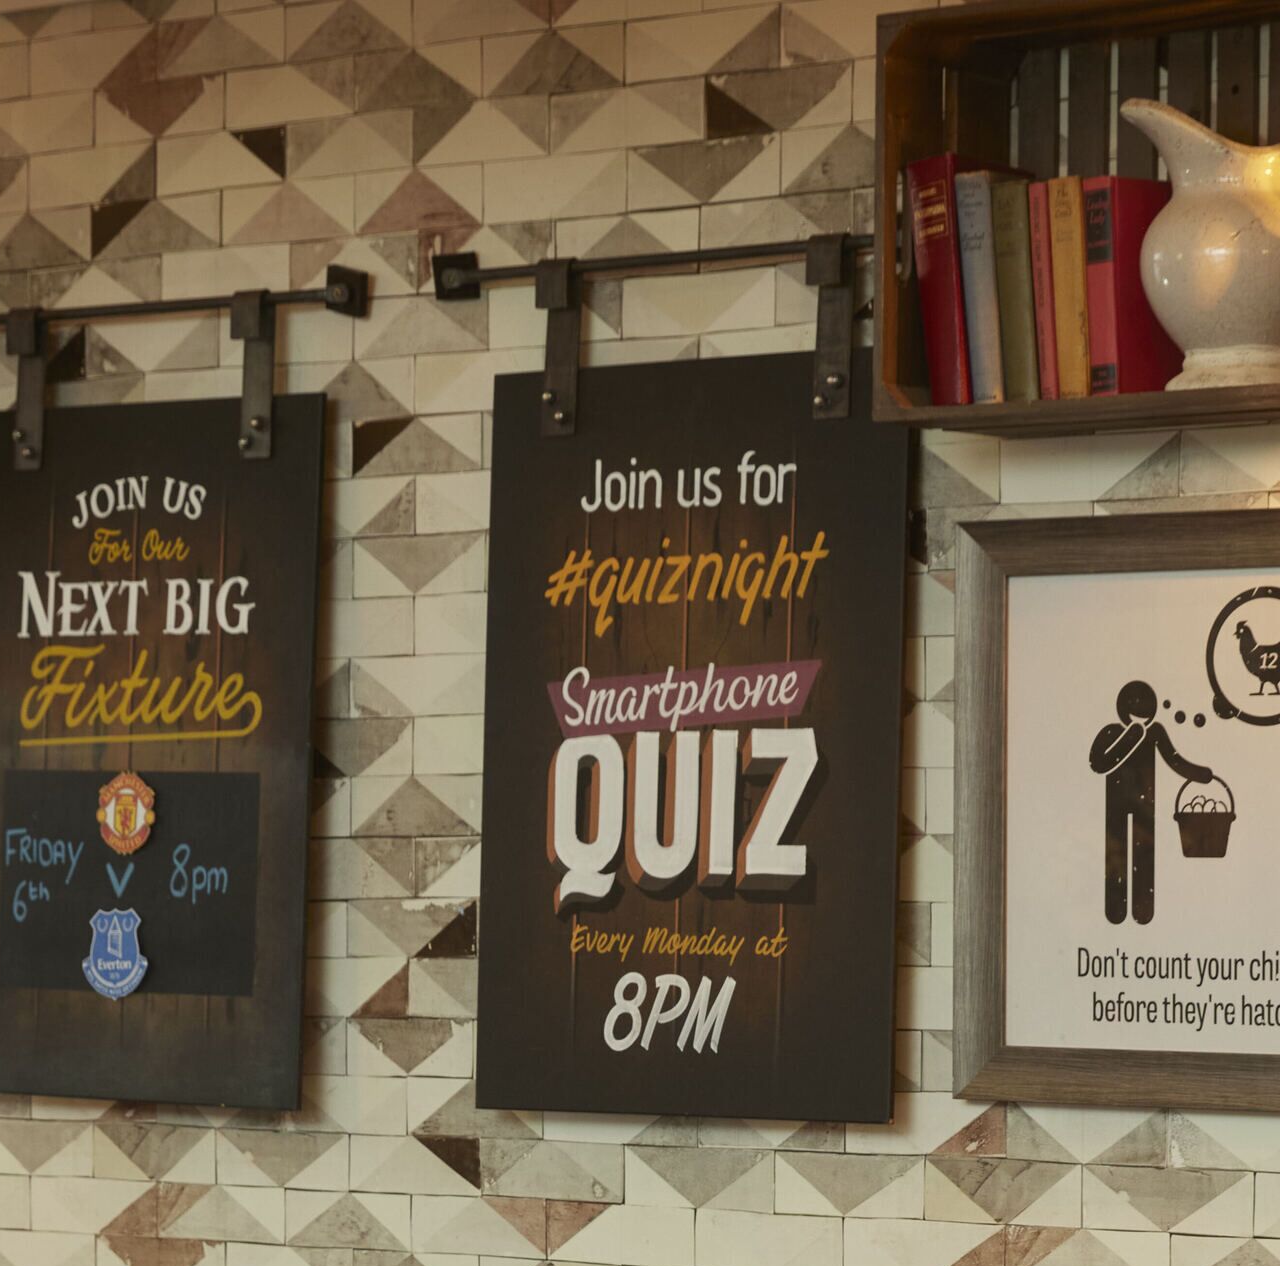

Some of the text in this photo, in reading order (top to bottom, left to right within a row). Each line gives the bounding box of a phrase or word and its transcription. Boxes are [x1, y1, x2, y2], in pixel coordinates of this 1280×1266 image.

[72, 476, 207, 529] JOIN US
[581, 450, 797, 513] Join us for
[89, 527, 191, 565] For Our
[17, 571, 256, 639] NEXT BIG
[544, 531, 830, 639] #quiznight
[1259, 652, 1278, 669] 12
[19, 643, 263, 742] Fixture
[561, 662, 799, 733] Smartphone
[548, 728, 819, 908] QUIZ
[13, 880, 50, 922] 6th
[170, 844, 228, 904] 8pm
[97, 959, 132, 970] Everton
[570, 924, 789, 967] Every Monday at
[1077, 947, 1129, 979] Don't
[1134, 950, 1192, 982] count
[1196, 956, 1246, 987] your
[603, 971, 737, 1055] 8PM
[1092, 991, 1158, 1024] before
[1162, 993, 1236, 1032] they're
